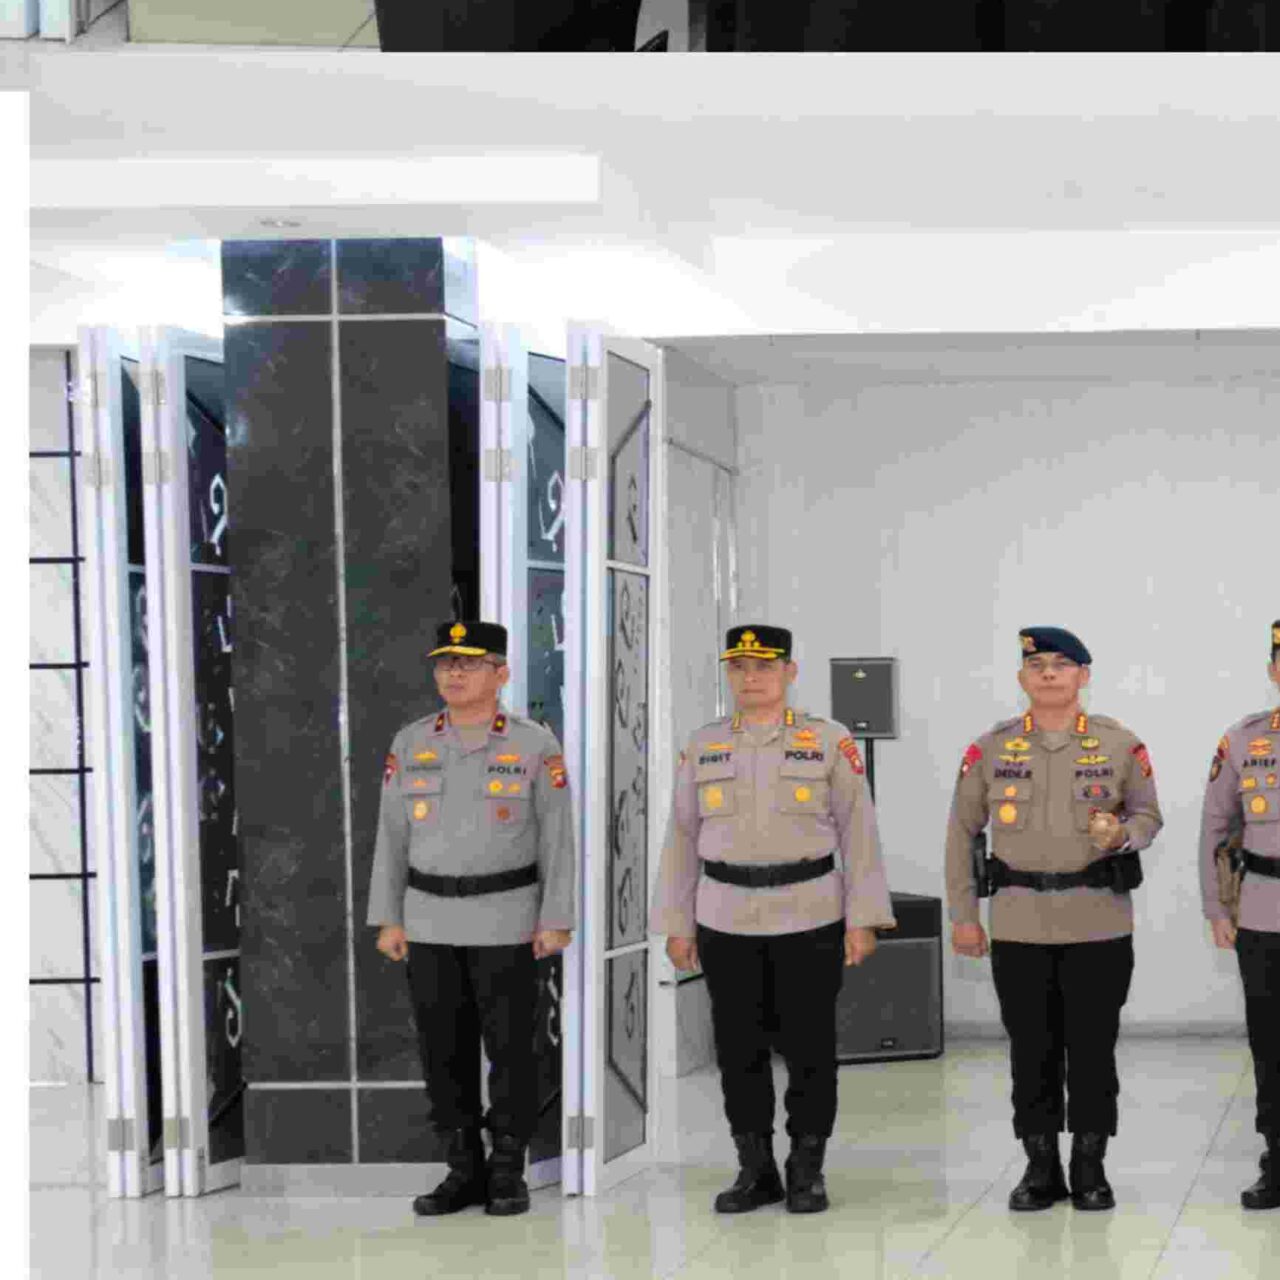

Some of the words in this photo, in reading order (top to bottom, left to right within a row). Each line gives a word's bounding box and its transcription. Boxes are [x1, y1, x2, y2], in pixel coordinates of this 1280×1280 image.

[784, 750, 824, 762] POLRI
[1243, 758, 1278, 768] ARIEF
[487, 765, 527, 775] POLRI
[1075, 766, 1114, 778] POLRI
